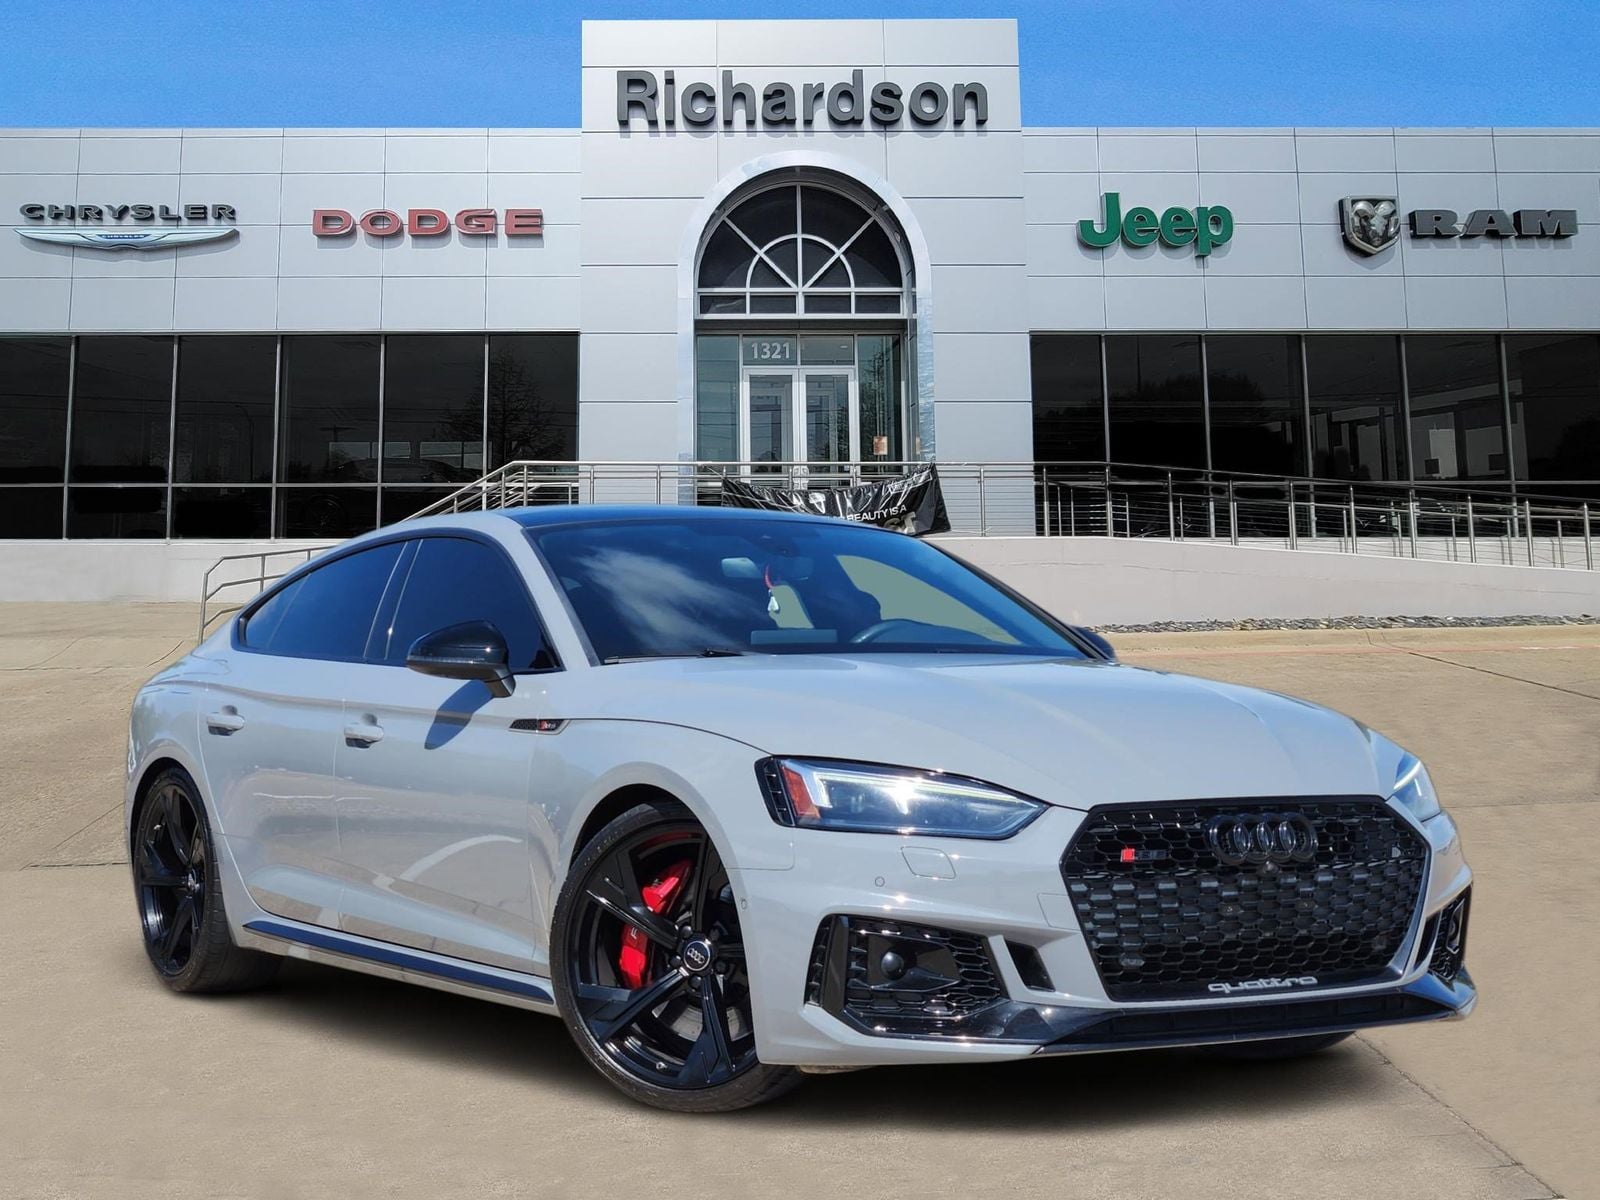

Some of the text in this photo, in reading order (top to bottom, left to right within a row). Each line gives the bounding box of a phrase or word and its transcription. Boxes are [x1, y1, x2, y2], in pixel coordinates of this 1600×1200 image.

[616, 69, 989, 127] Richardson
[19, 203, 236, 220] CHRYSLER
[312, 208, 544, 236] DODGE
[1077, 192, 1233, 257] Jeep
[1409, 209, 1578, 238] RAM
[751, 342, 790, 359] 1321
[847, 509, 888, 522] BEAUTY
[889, 506, 899, 516] IS
[900, 504, 907, 513] A
[1207, 976, 1318, 994] quattro
